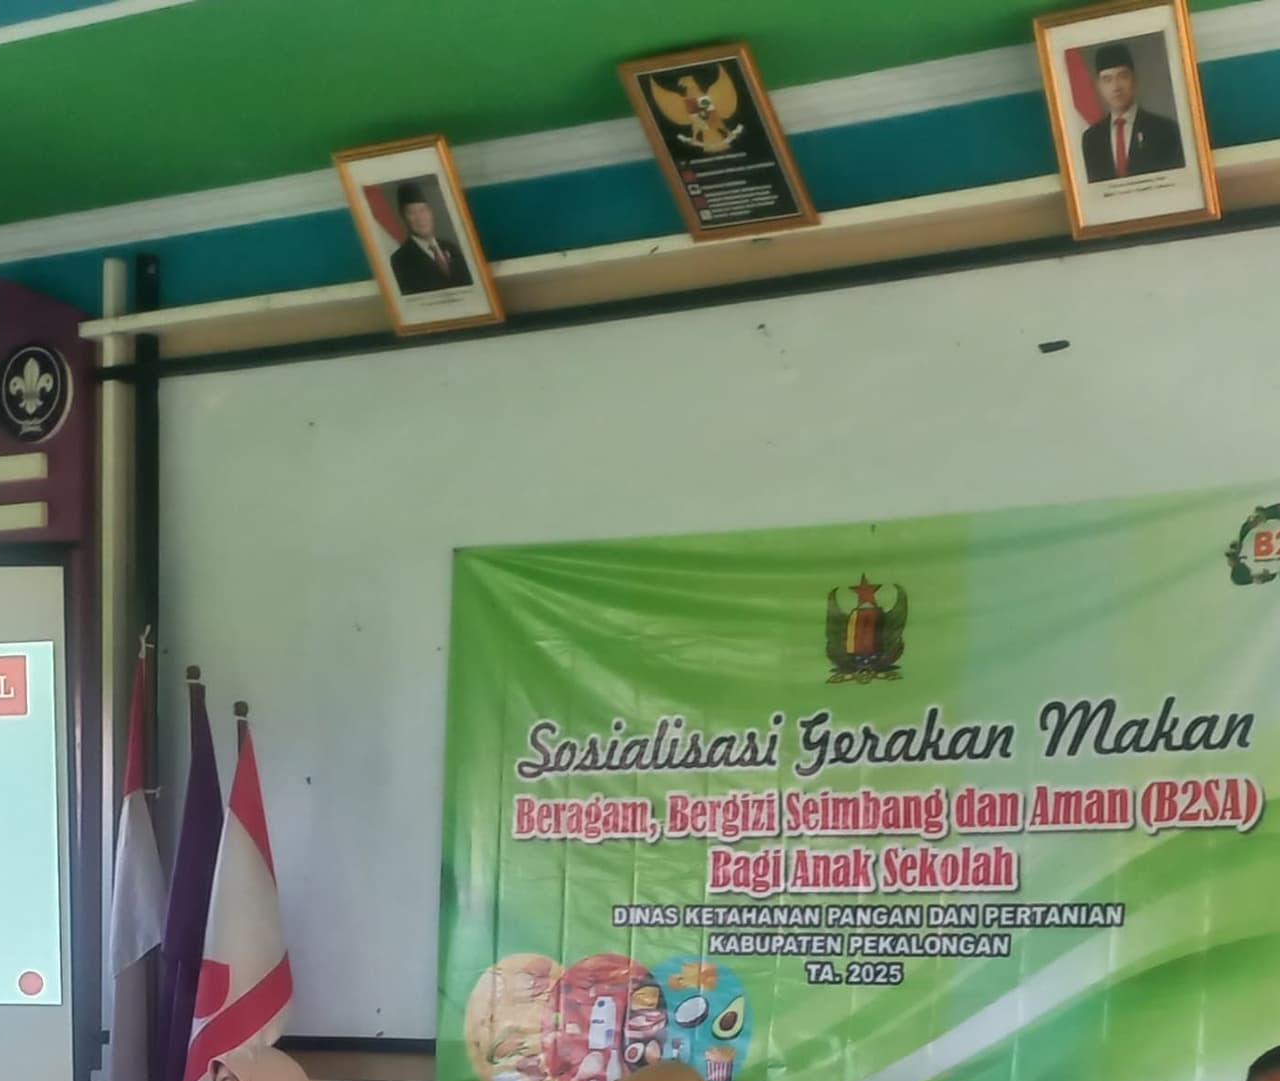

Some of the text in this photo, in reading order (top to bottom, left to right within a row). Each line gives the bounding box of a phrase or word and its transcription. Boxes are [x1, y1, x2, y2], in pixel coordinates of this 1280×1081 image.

[518, 696, 1255, 778] Sosialisasi Gerakan Makan
[515, 778, 1258, 838] Beragam, Bergizi Seimbang dan Aman (B2SA)
[710, 845, 1013, 892] Bagi Anak Sekolah
[614, 904, 1123, 926] DINAS KETAHANAN PANGAN DAN PERTANIAN
[709, 935, 1009, 955] KABUPATEN PEKALONGAN
[807, 963, 902, 983] TA. 2025
